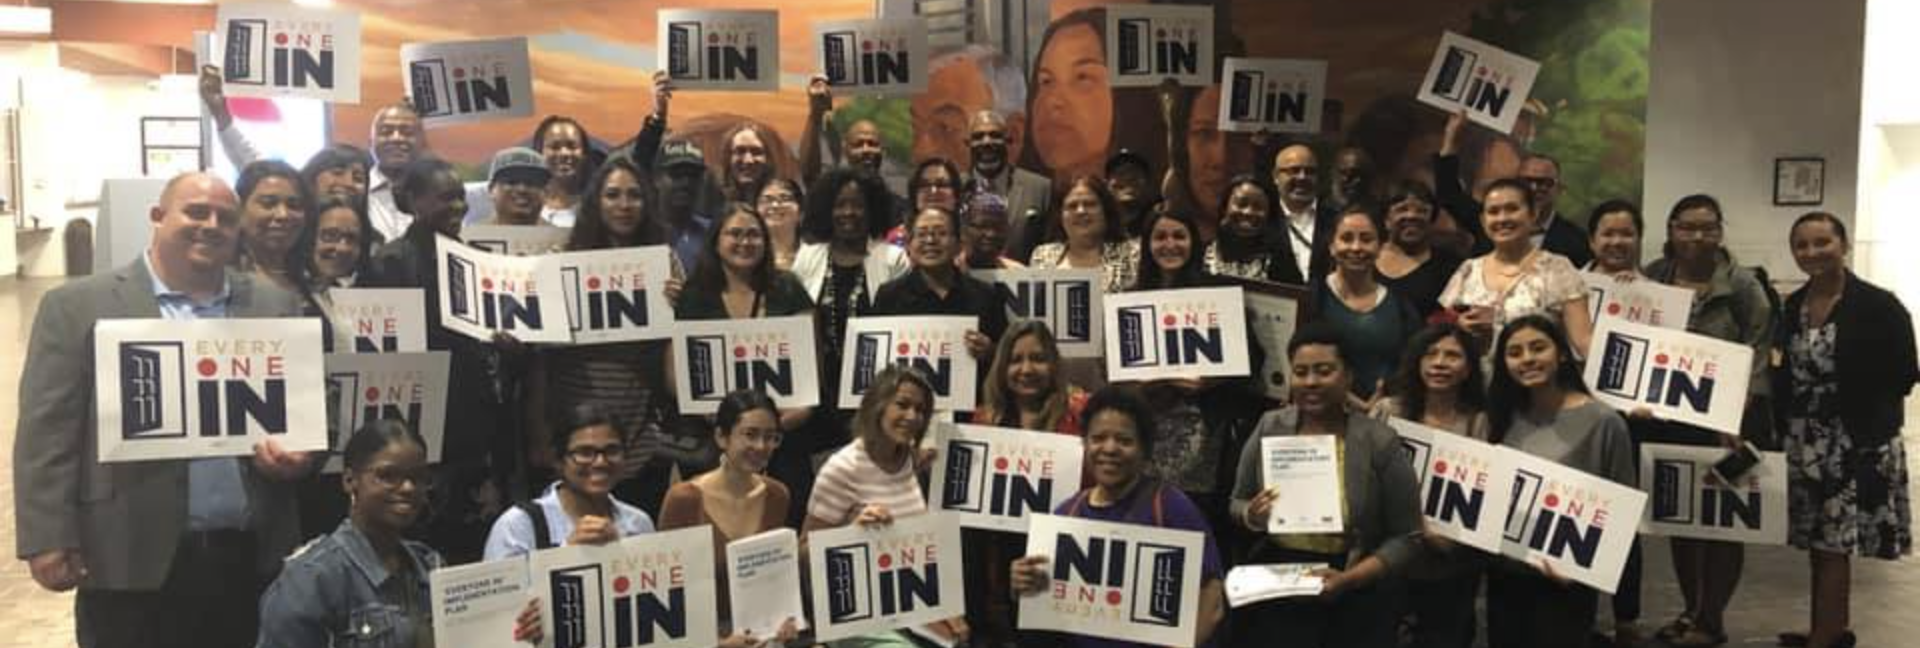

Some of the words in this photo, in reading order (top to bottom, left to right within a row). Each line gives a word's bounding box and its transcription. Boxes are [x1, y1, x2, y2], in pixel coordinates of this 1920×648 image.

[275, 33, 333, 48] ONE
[274, 48, 334, 89] IN
[708, 46, 757, 80] IN
[862, 51, 909, 84] IN
[1156, 40, 1198, 75] IN
[454, 76, 511, 113] IN
[1265, 92, 1308, 123] IN
[1465, 77, 1511, 118] IN
[481, 277, 537, 293] ONE
[587, 274, 646, 289] ONE
[358, 318, 397, 334] NE
[481, 291, 543, 330] IN
[587, 289, 649, 330] IN
[1163, 312, 1219, 327] ONE
[1607, 302, 1664, 325] ONE
[197, 340, 286, 354] EVERY
[734, 342, 791, 358] ONE
[897, 342, 951, 356] ONE
[1164, 327, 1224, 365] IN
[197, 356, 285, 377] ONE
[734, 358, 793, 396] IN
[1654, 353, 1719, 376] ONE
[365, 386, 423, 402] ONE
[1645, 366, 1715, 414] IN
[197, 379, 288, 436] IN
[994, 456, 1055, 476] ONE
[1433, 459, 1489, 489] ONE
[990, 472, 1054, 517] IN
[1424, 475, 1485, 532] IN
[1543, 493, 1610, 528] ONE
[1702, 488, 1761, 530] IN
[1528, 508, 1604, 569] IN
[878, 544, 938, 570] ONE
[1053, 532, 1127, 588] IN
[612, 565, 685, 594] ONE
[878, 562, 941, 616] IN
[1053, 581, 1123, 606] ONE
[613, 587, 687, 648] IN
